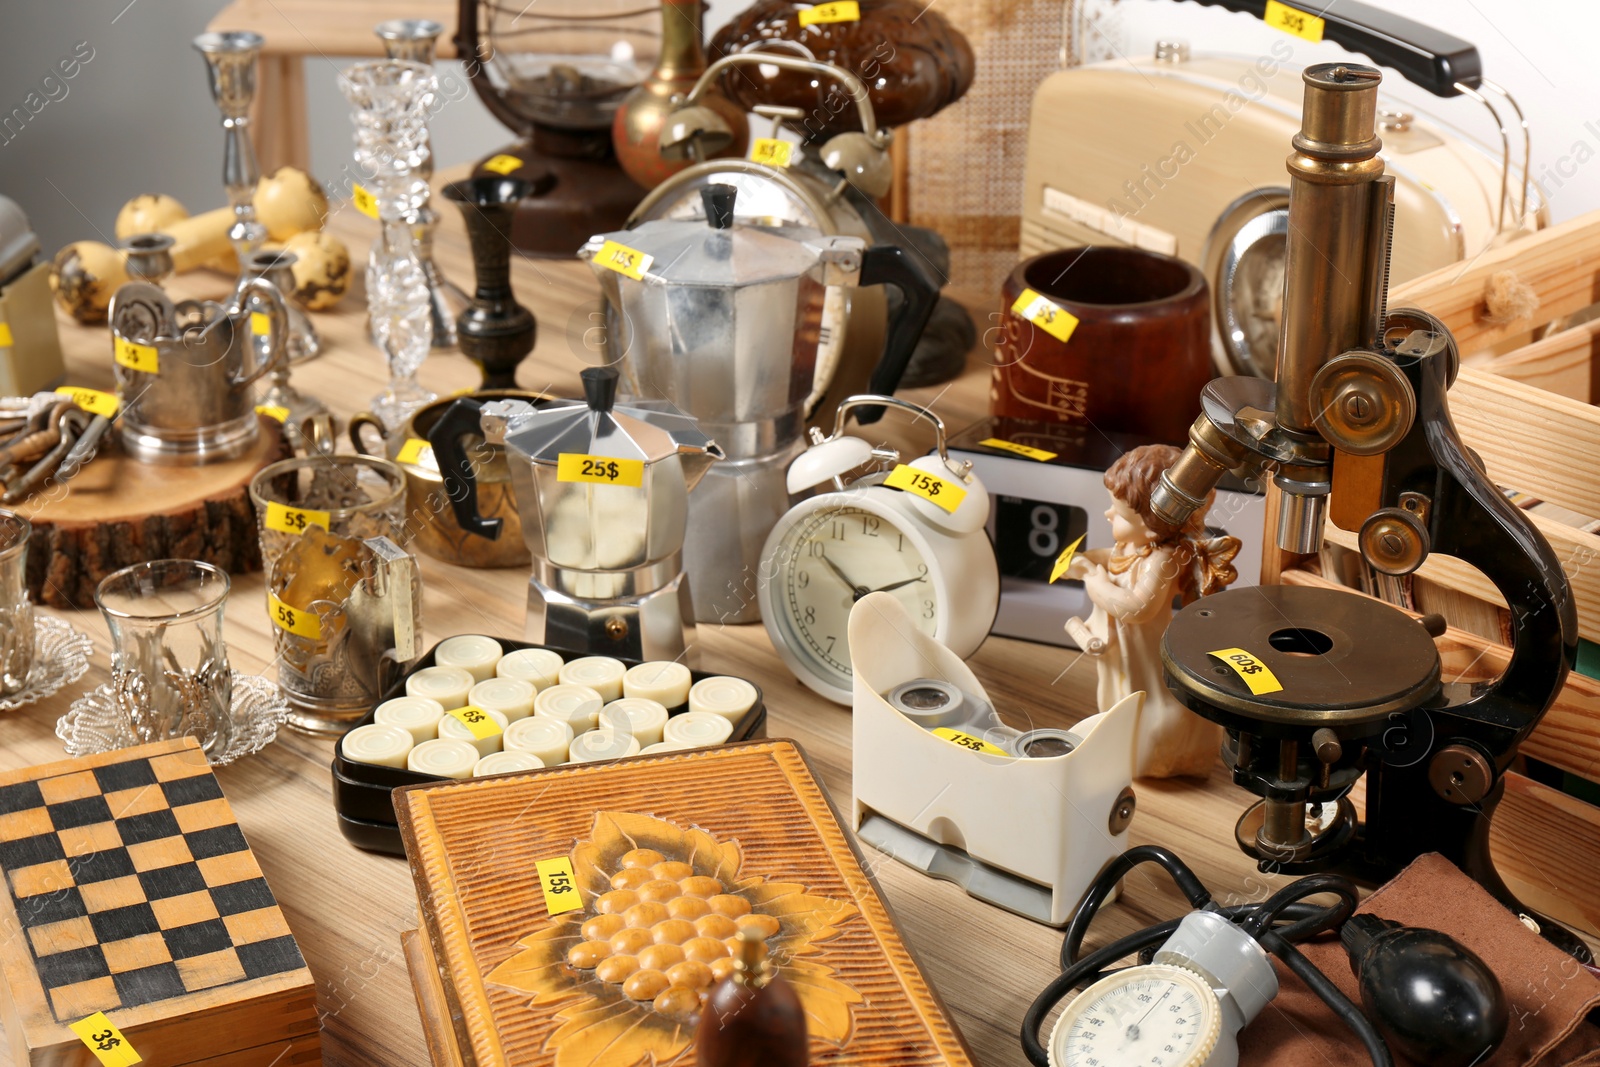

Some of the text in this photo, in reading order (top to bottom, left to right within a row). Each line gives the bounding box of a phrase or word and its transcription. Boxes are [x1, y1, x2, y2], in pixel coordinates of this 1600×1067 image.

[610, 249, 635, 269] 15$
[1036, 305, 1058, 325] 5$
[581, 459, 620, 481] 25$
[911, 473, 943, 497] 15$
[284, 511, 307, 531] 5$
[831, 520, 846, 541] 11
[862, 517, 881, 537] 12
[1028, 505, 1059, 558] 8
[808, 540, 827, 557] 10
[897, 534, 904, 553] 1
[798, 571, 810, 590] 9
[917, 564, 930, 583] 2
[278, 605, 296, 629] 5$
[804, 606, 815, 626] 8
[922, 600, 935, 620] 3
[826, 636, 837, 655] 7
[1229, 654, 1262, 676] 60$
[463, 710, 486, 724] 6$
[949, 733, 985, 752] 15$
[548, 870, 572, 895] 15$
[1138, 994, 1153, 1003] 300
[1169, 1005, 1181, 1014] 20
[1090, 1017, 1105, 1027] 240
[1176, 1017, 1188, 1026] 40
[91, 1029, 121, 1052] 3$
[1082, 1032, 1096, 1041] 220
[1086, 1057, 1100, 1067] 180
